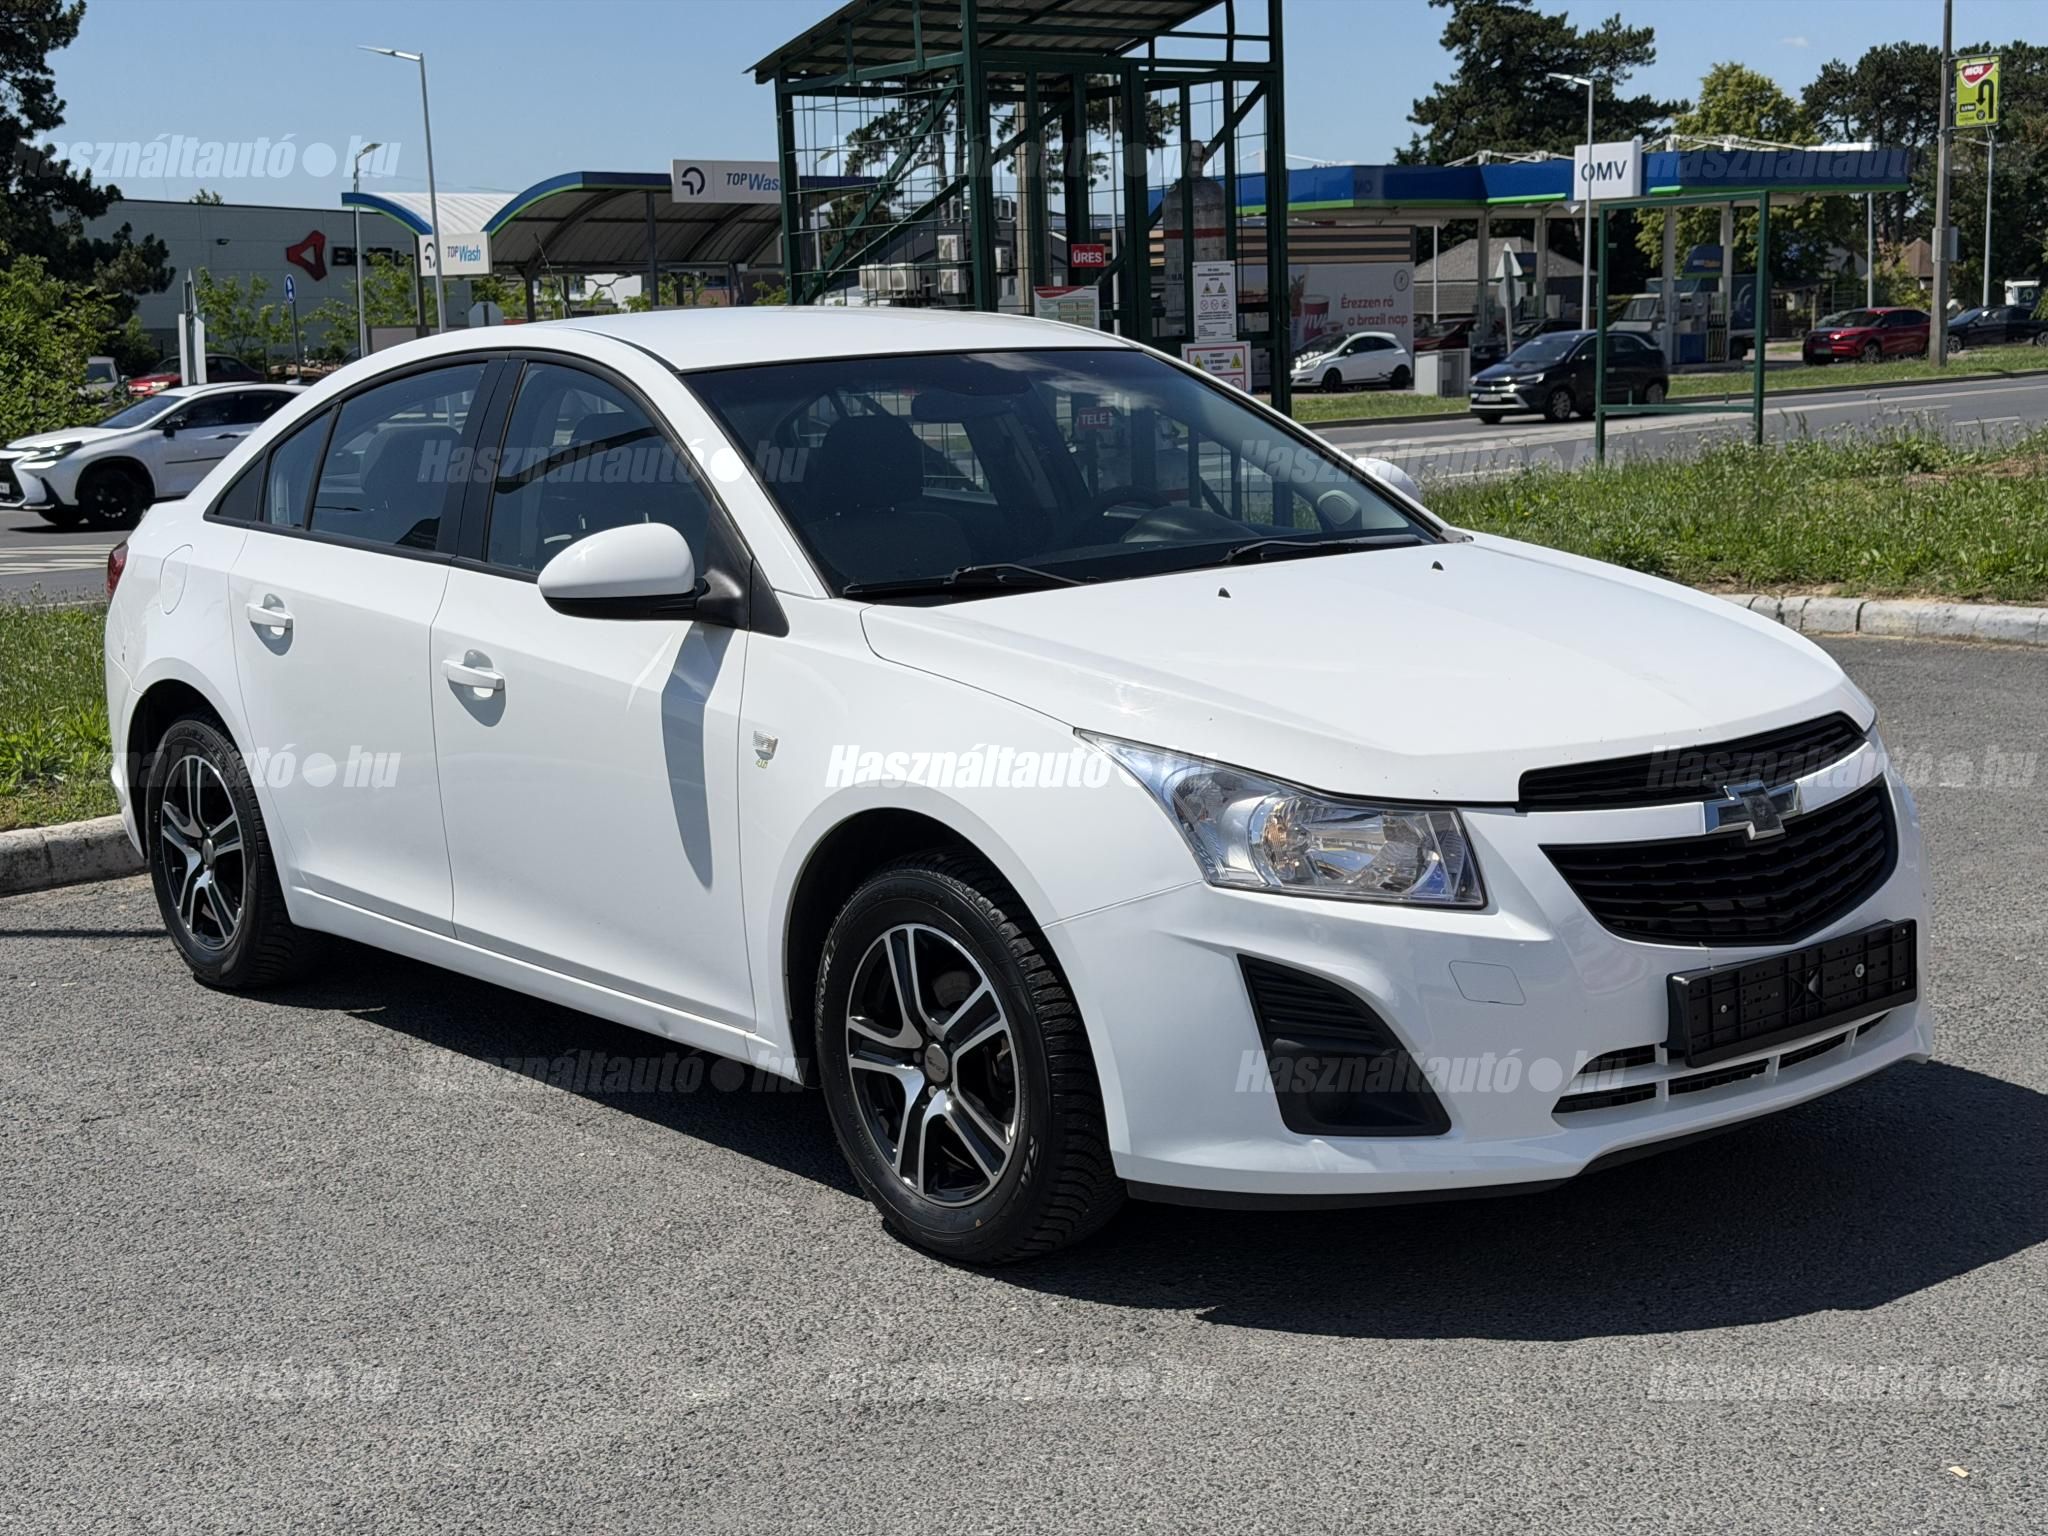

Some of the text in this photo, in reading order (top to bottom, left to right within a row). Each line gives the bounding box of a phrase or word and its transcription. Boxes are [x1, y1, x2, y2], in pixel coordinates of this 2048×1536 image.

[1580, 160, 1628, 183] OMV
[1073, 250, 1102, 264] ÜRES
[1341, 294, 1381, 309] Érezzen
[1357, 315, 1386, 326] brazil
